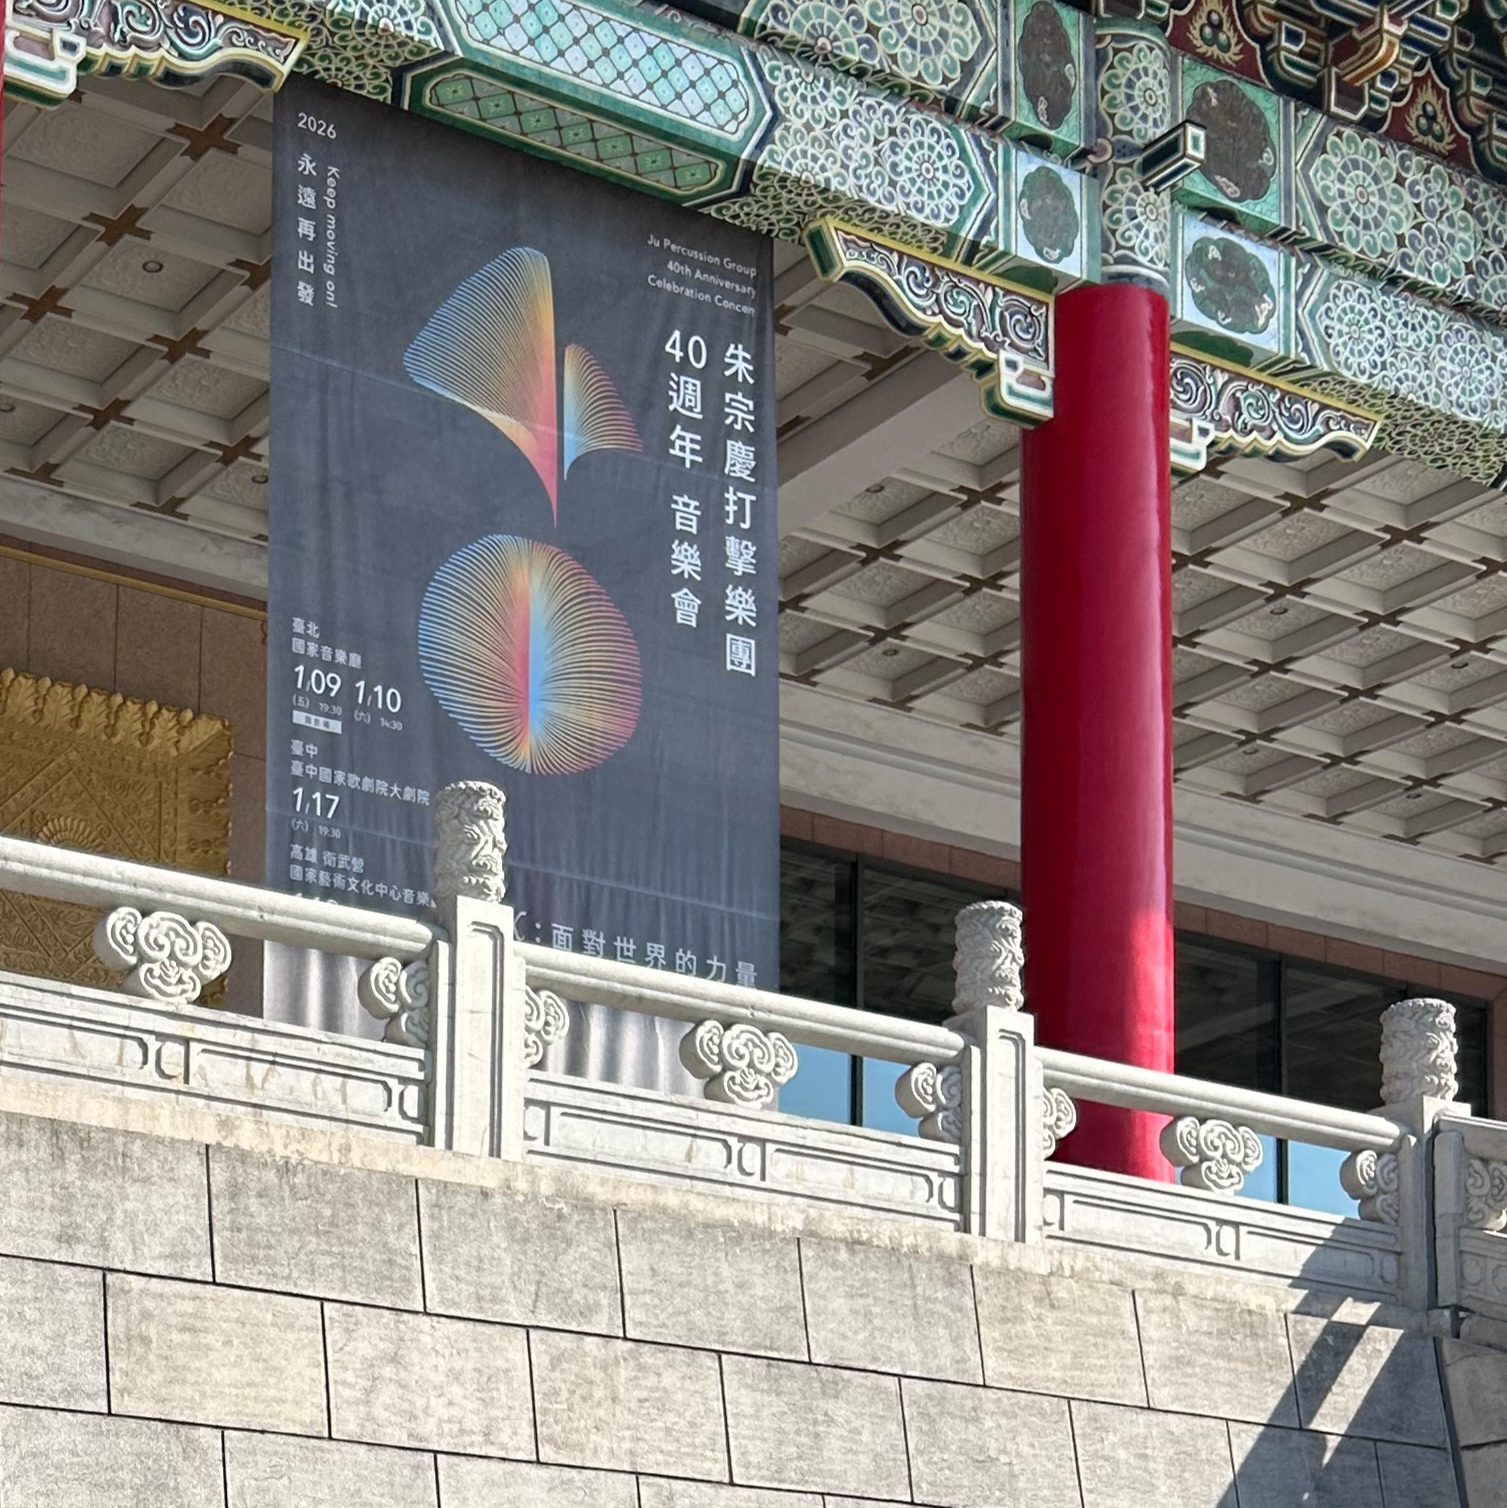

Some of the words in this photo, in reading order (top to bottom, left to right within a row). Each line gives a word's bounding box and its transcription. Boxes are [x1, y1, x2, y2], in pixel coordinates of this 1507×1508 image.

[297, 112, 337, 139] 2026
[323, 166, 340, 209] Keep
[297, 153, 317, 306] 永遠再出發
[323, 214, 339, 275] moving
[647, 234, 660, 248] Ju
[663, 238, 721, 266] Percussion
[723, 258, 757, 278] Group
[326, 280, 338, 308] on!
[647, 274, 712, 303] Celebration
[667, 260, 692, 277] 40th
[694, 269, 756, 299] Anniversary
[664, 329, 707, 469] 40週年
[723, 342, 757, 677] 朱宗慶打擊樂團
[670, 493, 703, 627] 音樂會
[292, 617, 320, 638] 臺北
[292, 637, 362, 669] 國家音樂廳
[291, 739, 318, 759] 臺中
[291, 760, 430, 806] 臺中國家歌劇院大劇院
[293, 787, 340, 819] 1/17
[290, 844, 318, 864] 高雄
[290, 864, 436, 908] 國家藝術文化中心音樂
